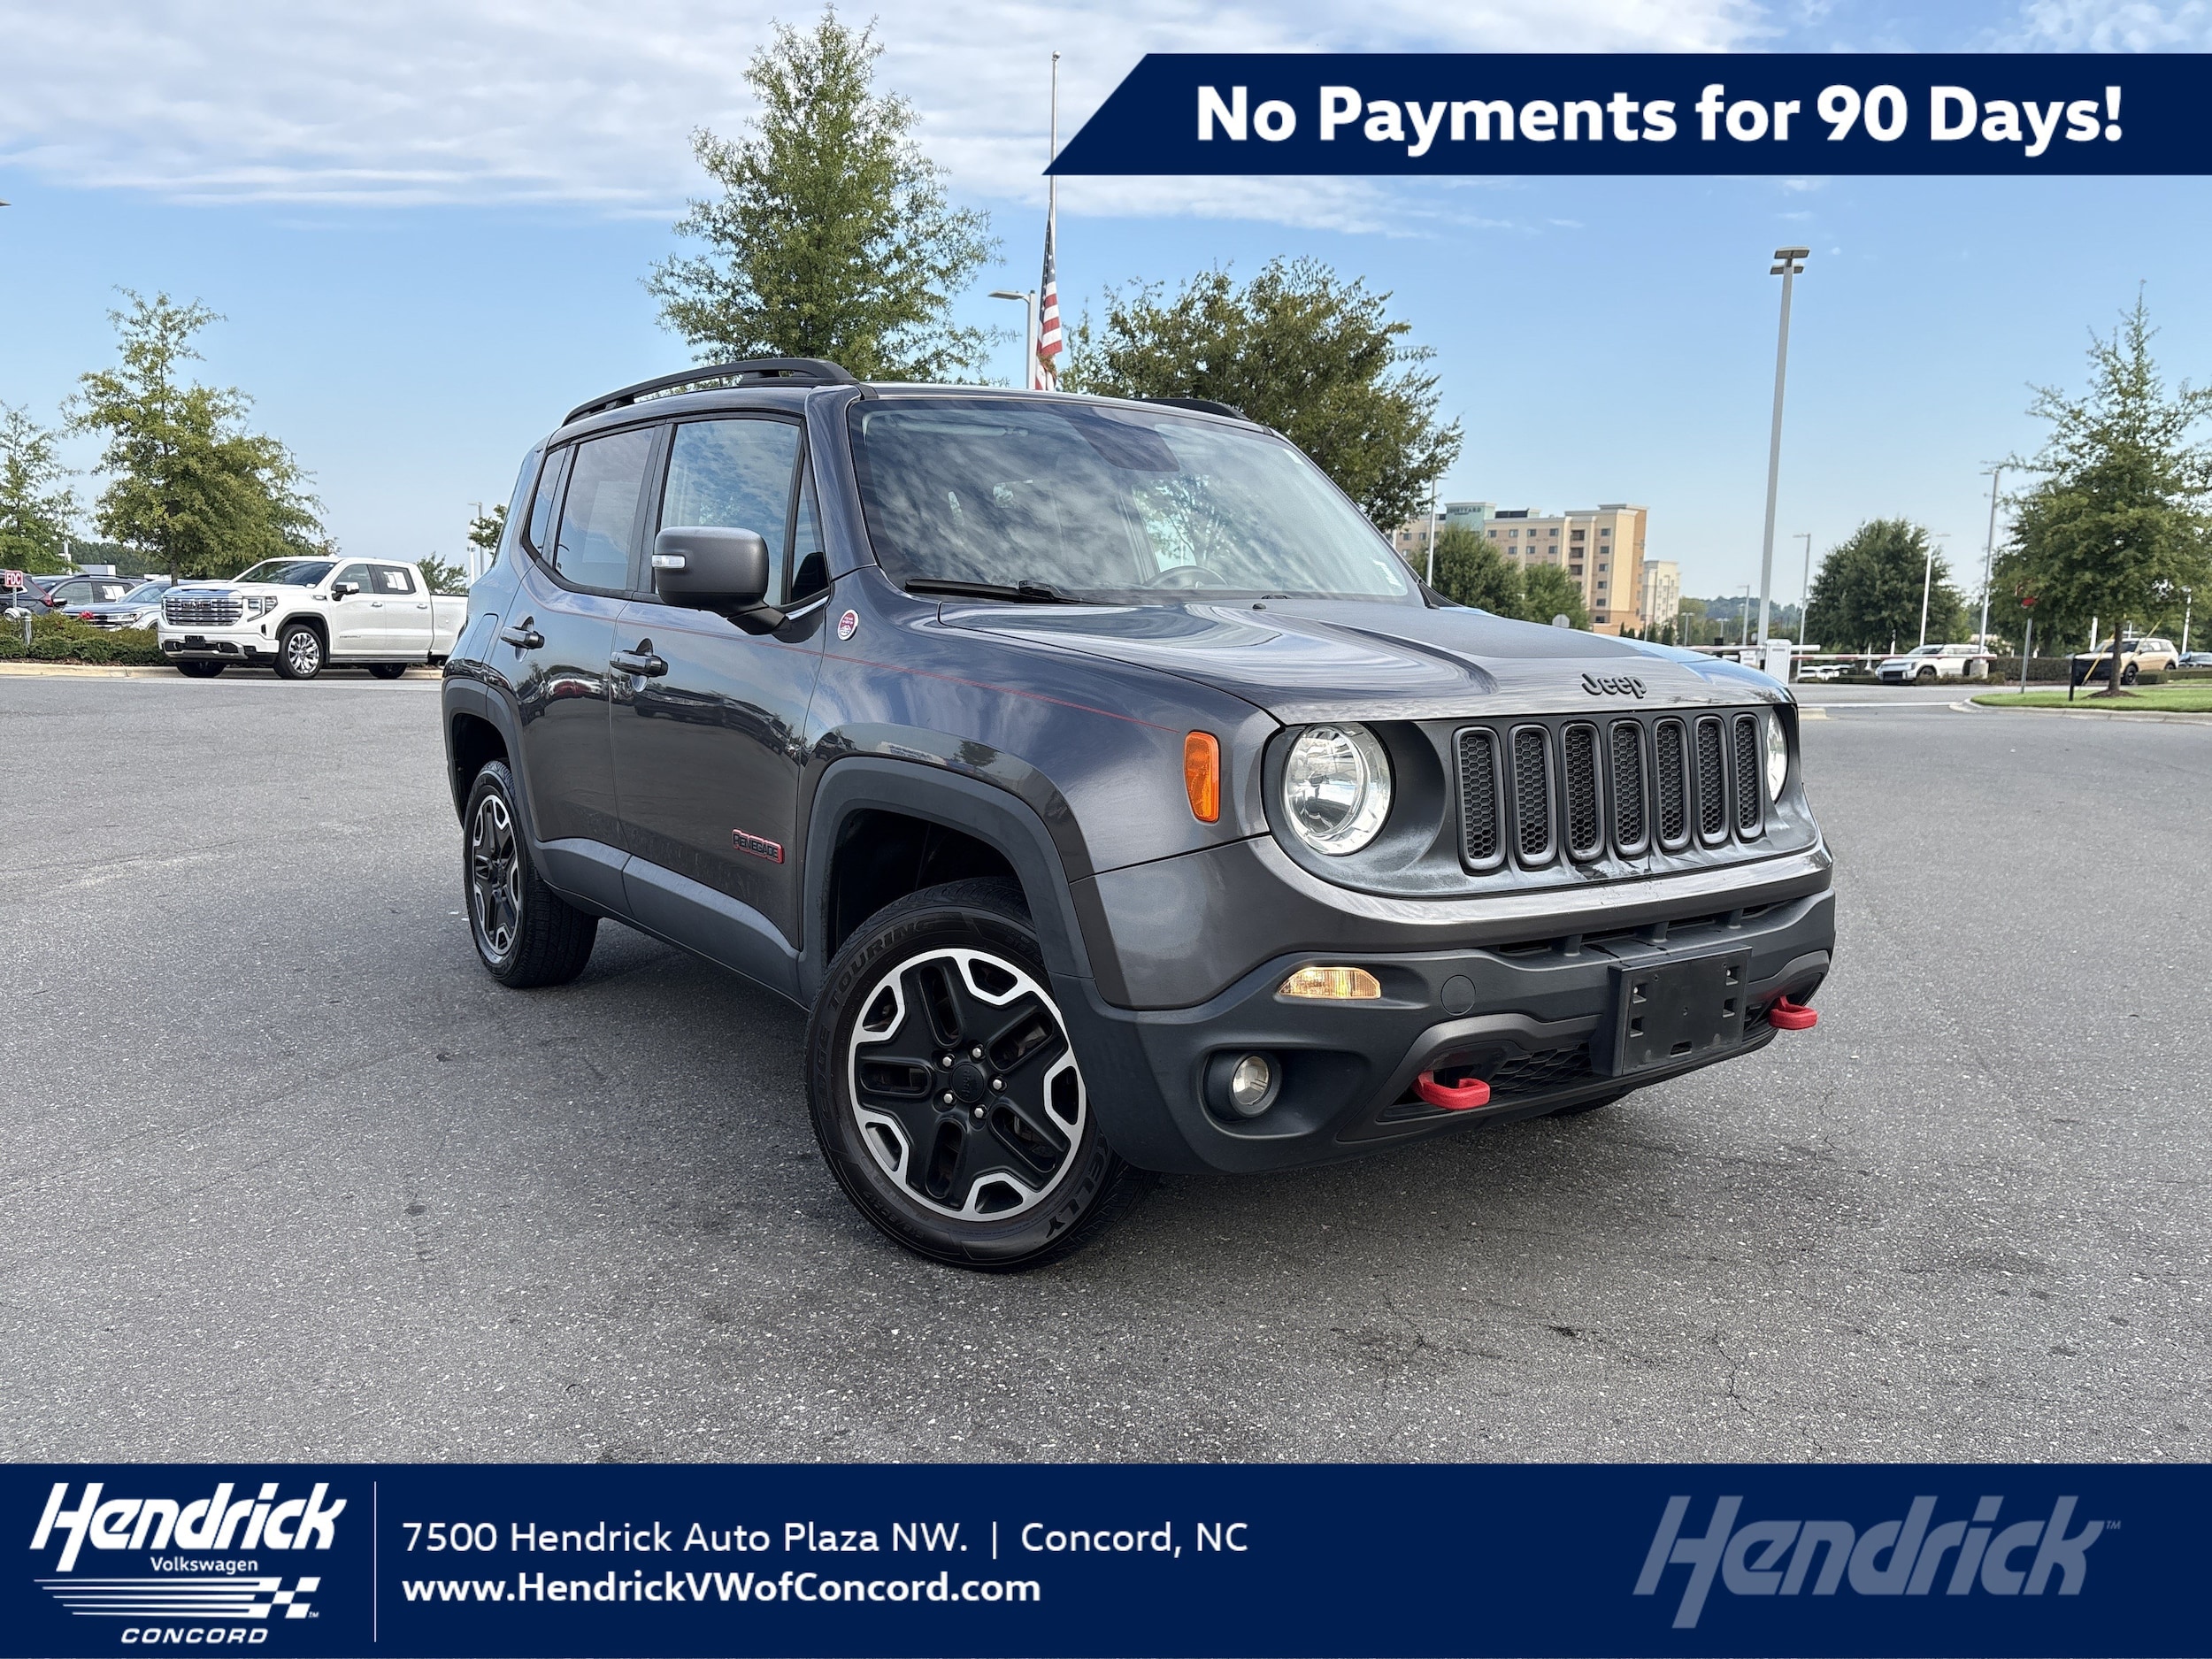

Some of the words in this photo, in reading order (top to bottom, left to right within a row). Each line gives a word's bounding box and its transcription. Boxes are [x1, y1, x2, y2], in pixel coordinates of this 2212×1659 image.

[6, 572, 21, 585] FDC
[1581, 673, 1647, 699] Jeep
[733, 833, 780, 859] RENEGADE
[829, 917, 936, 1010] TOURING
